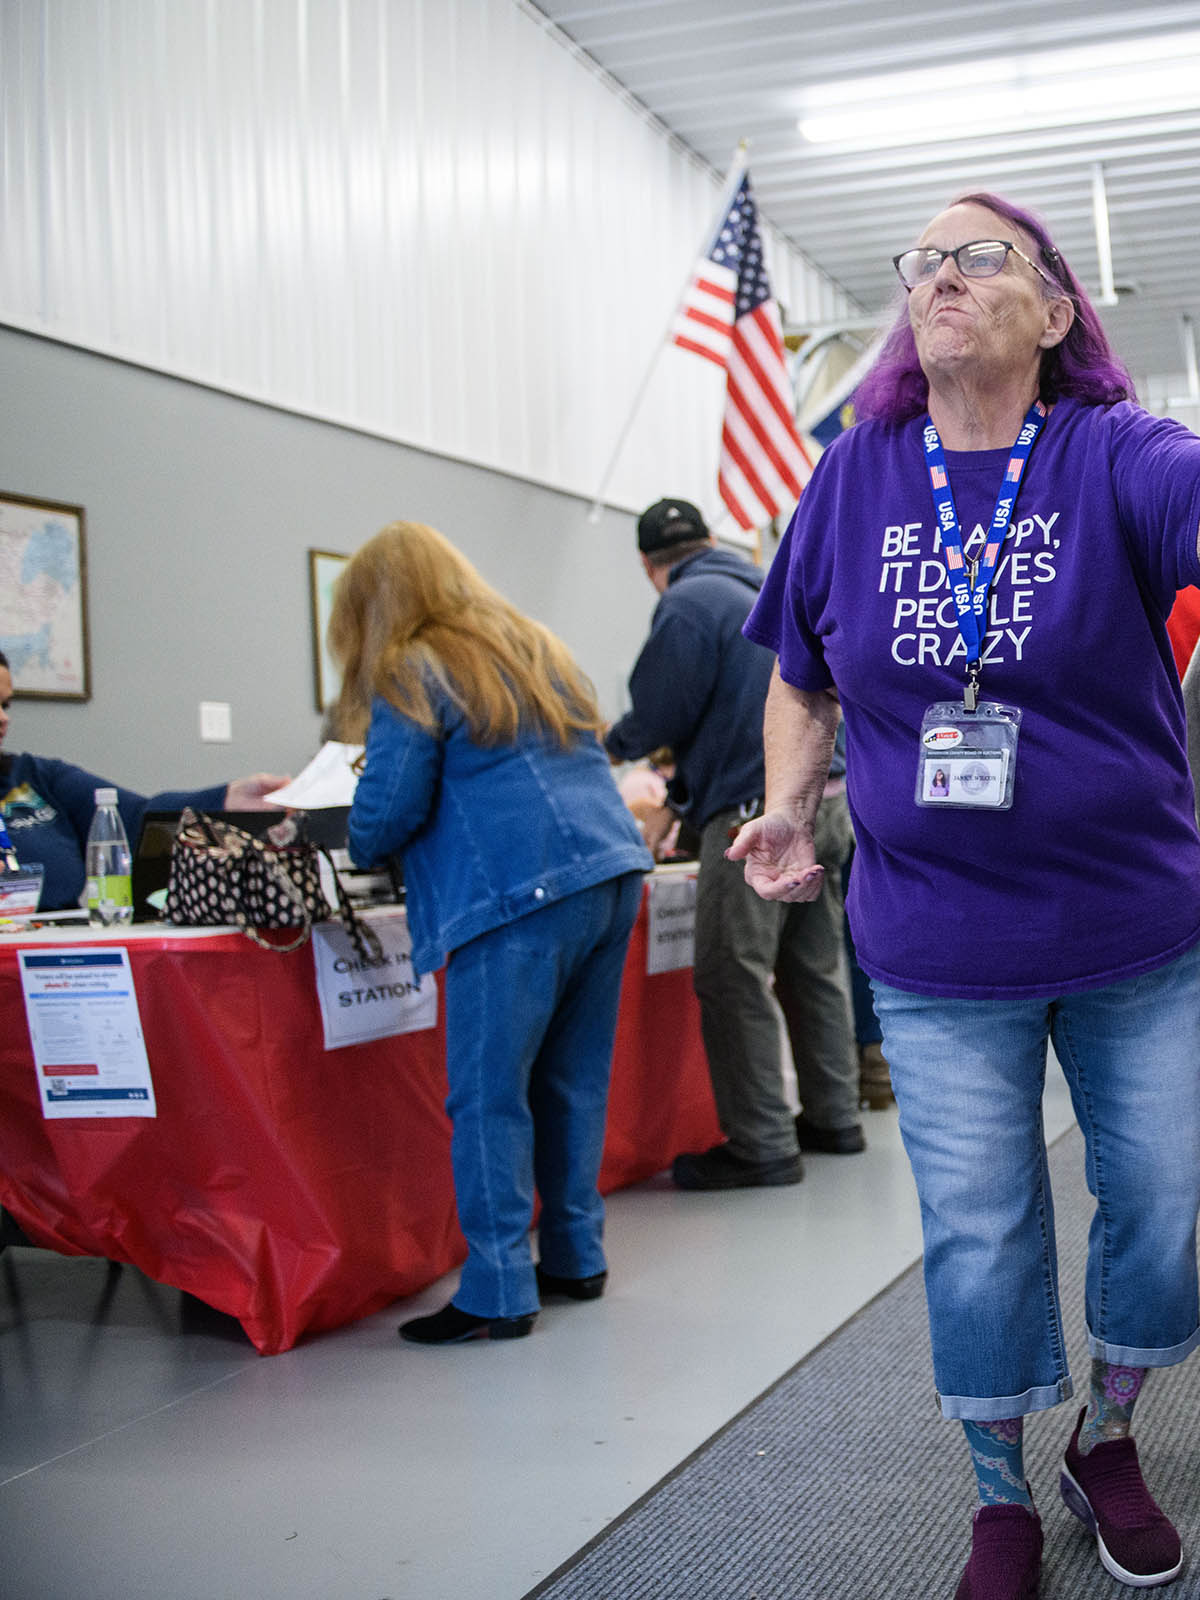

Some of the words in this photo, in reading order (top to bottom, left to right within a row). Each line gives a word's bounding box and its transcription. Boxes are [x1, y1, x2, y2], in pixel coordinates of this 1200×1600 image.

[924, 425, 940, 453] USA
[1017, 423, 1039, 446] USA
[938, 501, 956, 531] USA
[993, 498, 1013, 528] USA
[881, 523, 923, 557] BE
[933, 512, 1060, 553] APY,
[879, 561, 913, 593] IT
[918, 551, 1057, 593] DVES
[893, 590, 1034, 629] PEOLE
[954, 583, 972, 616] USA
[973, 583, 987, 616] USA
[891, 626, 1033, 668] CRAZY
[338, 982, 421, 1008] STATION
